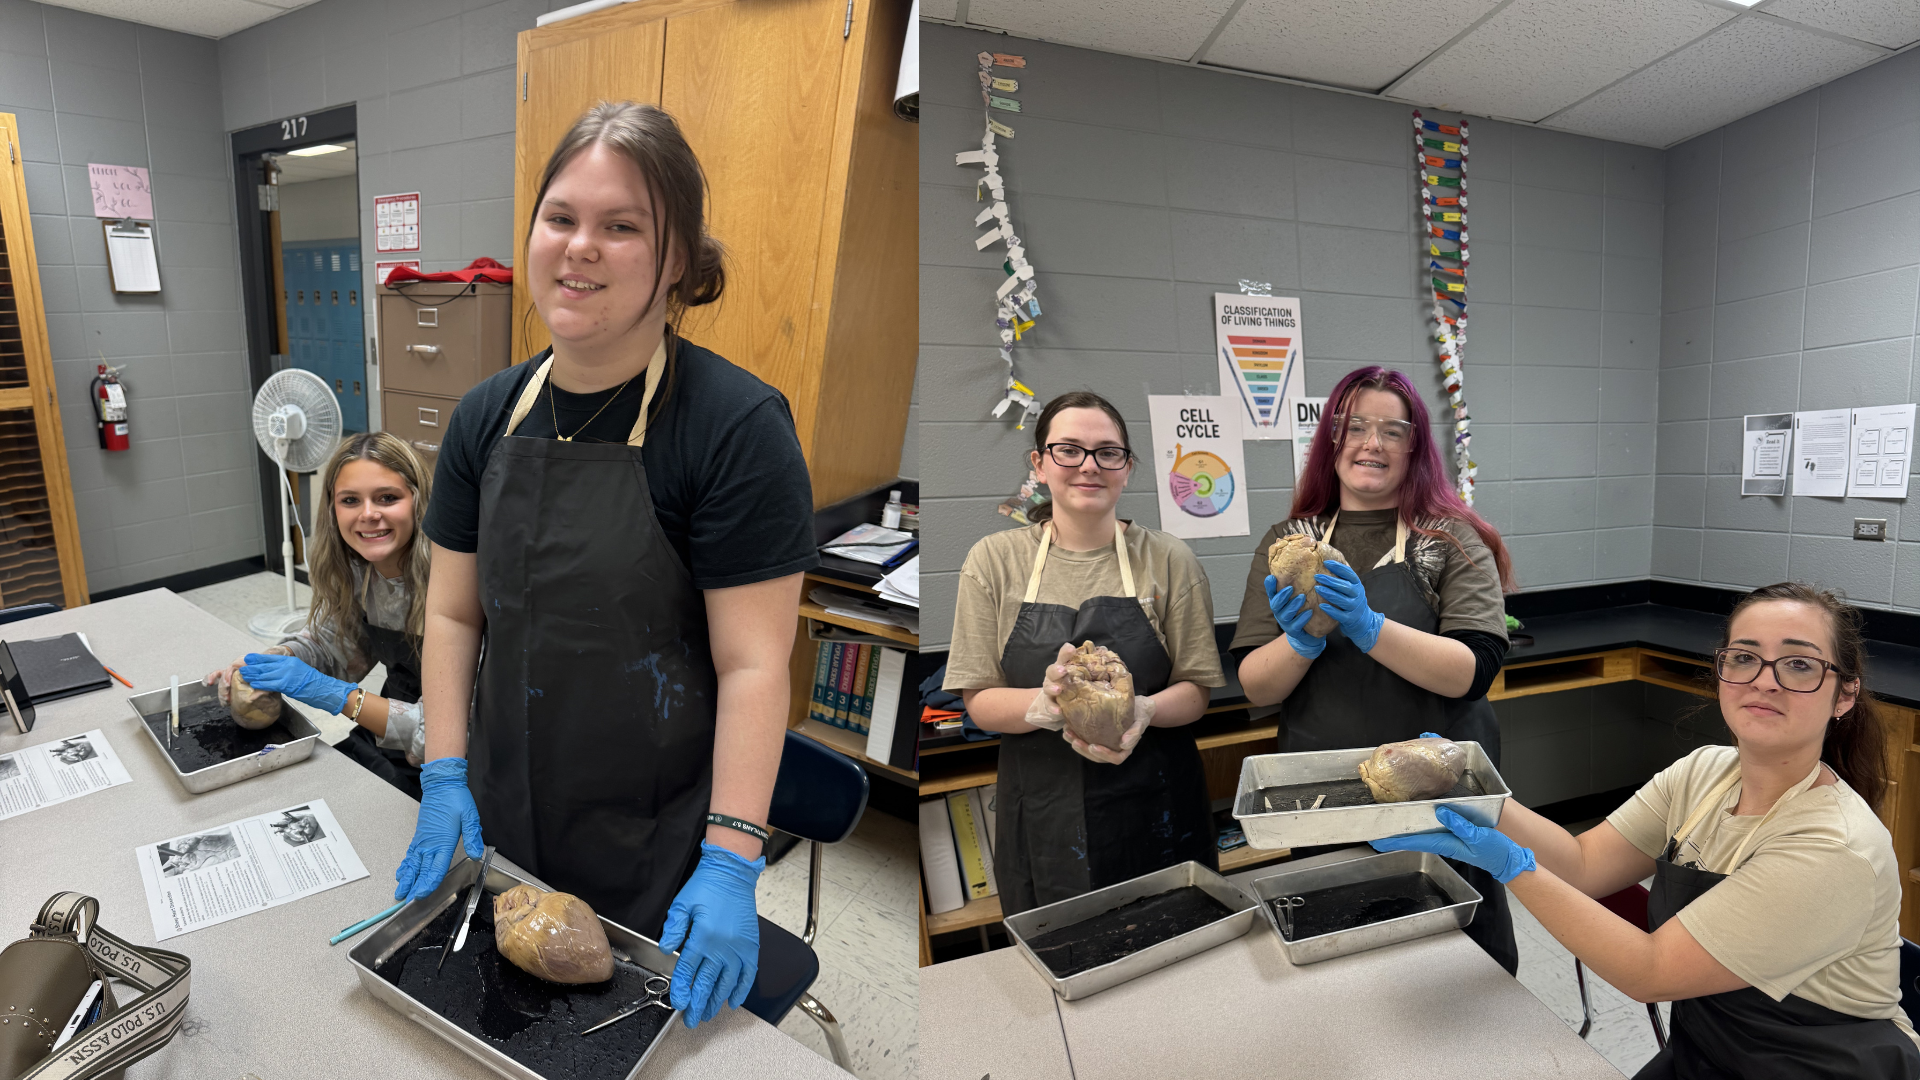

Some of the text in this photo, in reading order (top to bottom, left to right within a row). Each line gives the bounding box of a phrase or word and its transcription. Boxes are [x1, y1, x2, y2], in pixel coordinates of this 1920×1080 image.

[281, 116, 307, 140] 217
[1224, 305, 1292, 318] CLASSIFICATION
[1221, 316, 1296, 328] OF LIVING THINGS
[1180, 408, 1214, 422] CELL
[1297, 403, 1321, 422] DN
[1176, 424, 1220, 438] CYCLE
[832, 644, 841, 667] POPULAR
[845, 648, 854, 671] POPULAR
[859, 650, 867, 674] POPULAR
[871, 654, 879, 677] POPULAR
[817, 688, 821, 697] 1
[826, 692, 834, 700] 2
[839, 695, 846, 704] 3
[853, 699, 859, 707] 4
[865, 702, 871, 711] 5
[90, 937, 141, 974] U.S. POLO
[64, 1002, 166, 1066] U.S. POLO ASSN.
